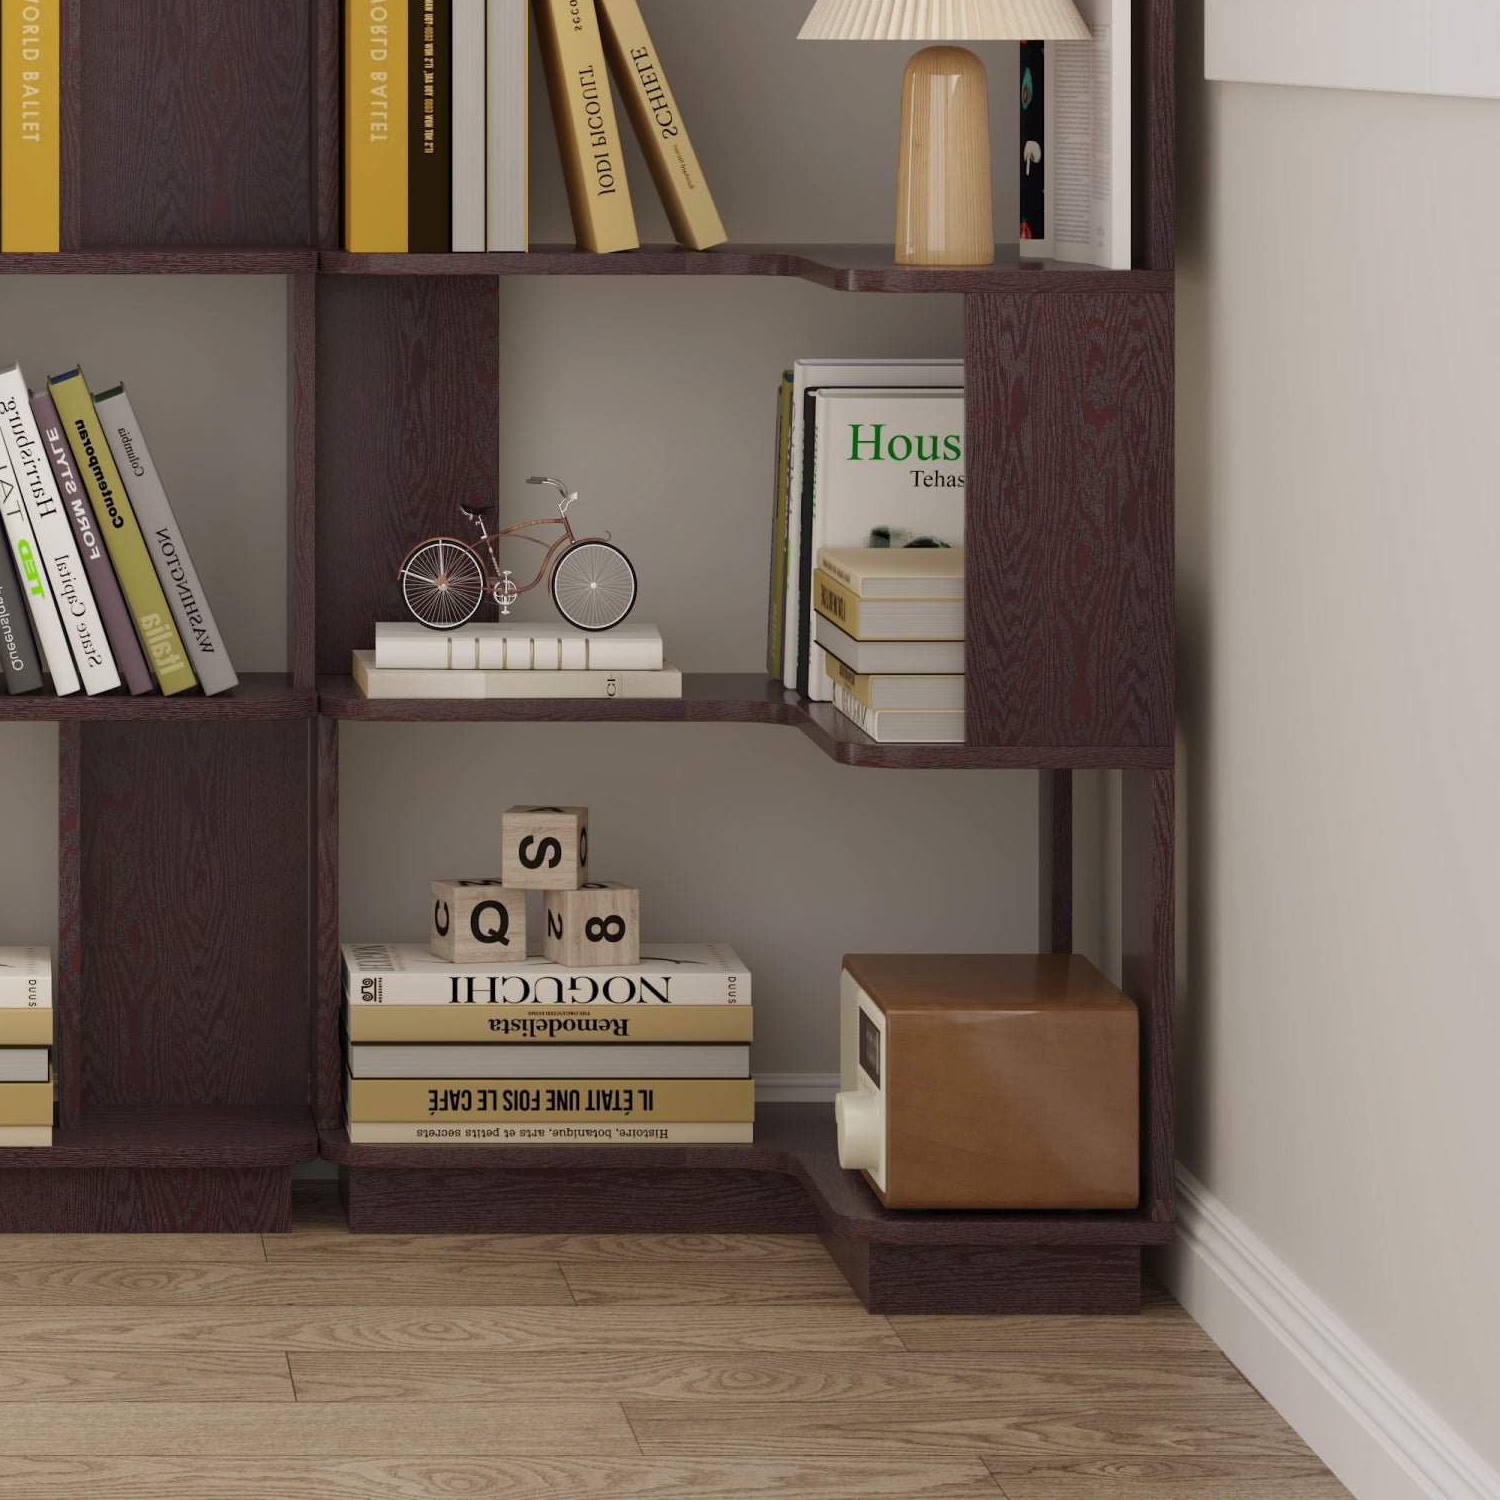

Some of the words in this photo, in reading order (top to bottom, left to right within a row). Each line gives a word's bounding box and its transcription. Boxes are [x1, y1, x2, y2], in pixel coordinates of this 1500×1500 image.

[21, 70, 40, 142] BALLET
[846, 423, 962, 461] Hous
[909, 470, 965, 488] Tehas
[518, 834, 562, 870] S
[470, 899, 511, 947] Q
[584, 914, 627, 943] 8
[447, 975, 673, 1005] NOGUCHI
[489, 1017, 630, 1037] Remodelista
